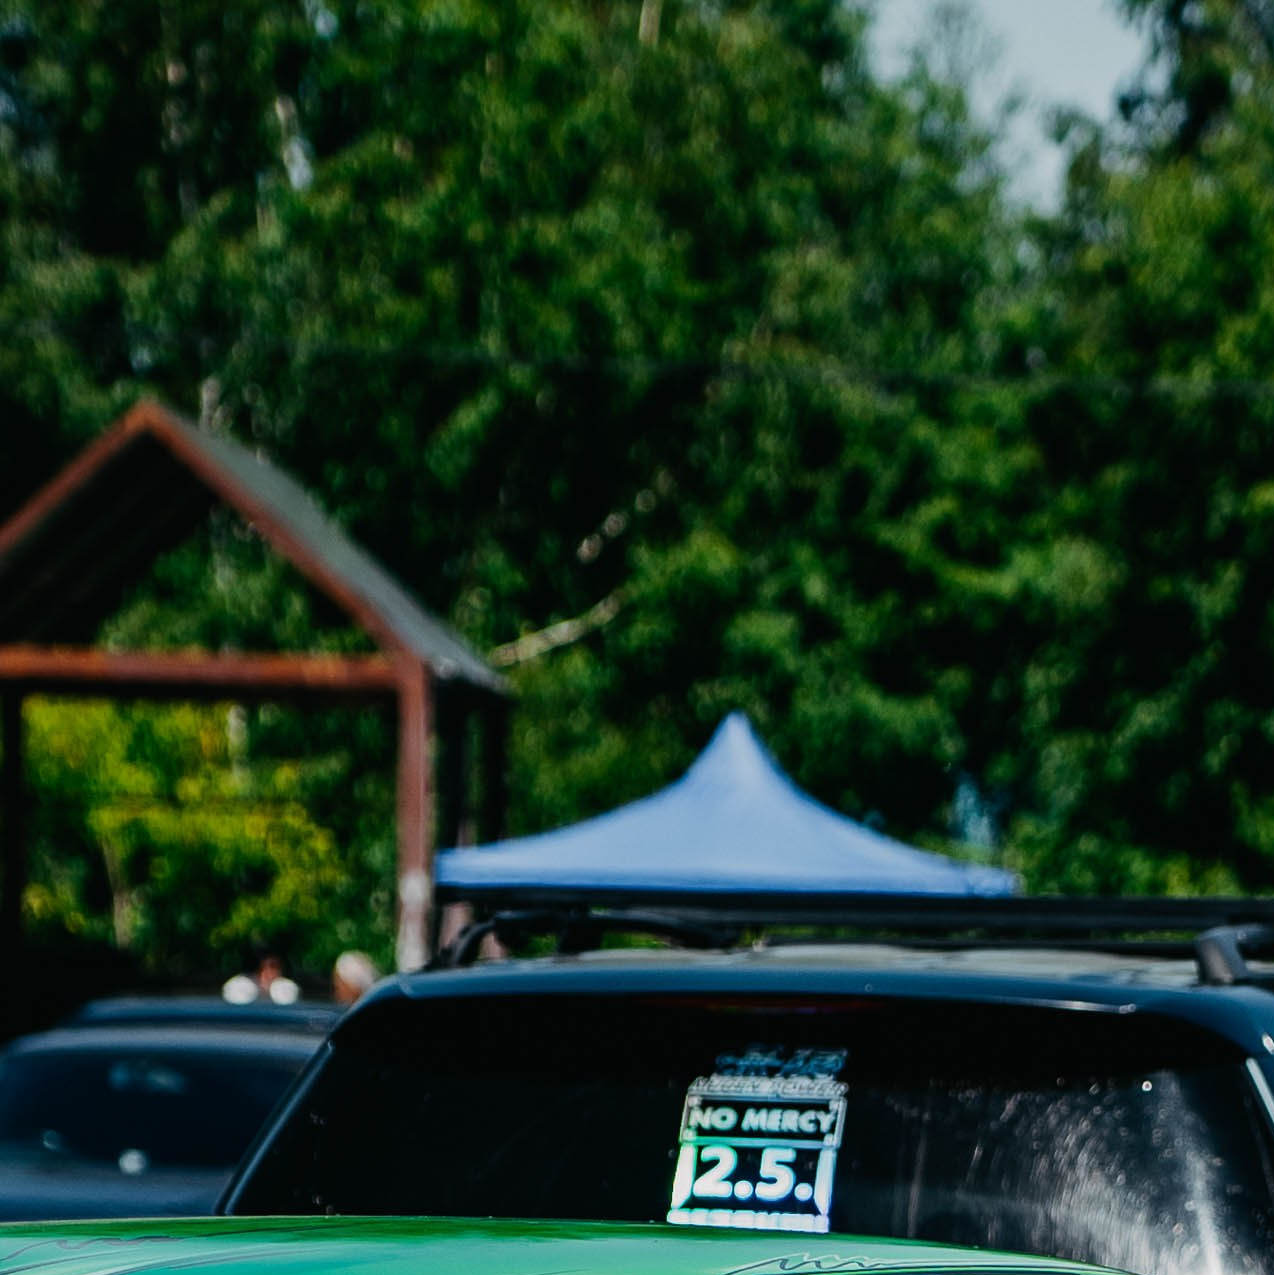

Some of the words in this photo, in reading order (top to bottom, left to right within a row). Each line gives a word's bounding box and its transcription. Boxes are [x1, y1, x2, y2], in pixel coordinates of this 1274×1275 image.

[689, 1106, 738, 1131] NO
[742, 1108, 837, 1133] MERCY
[692, 1144, 813, 1202] 2.5.
